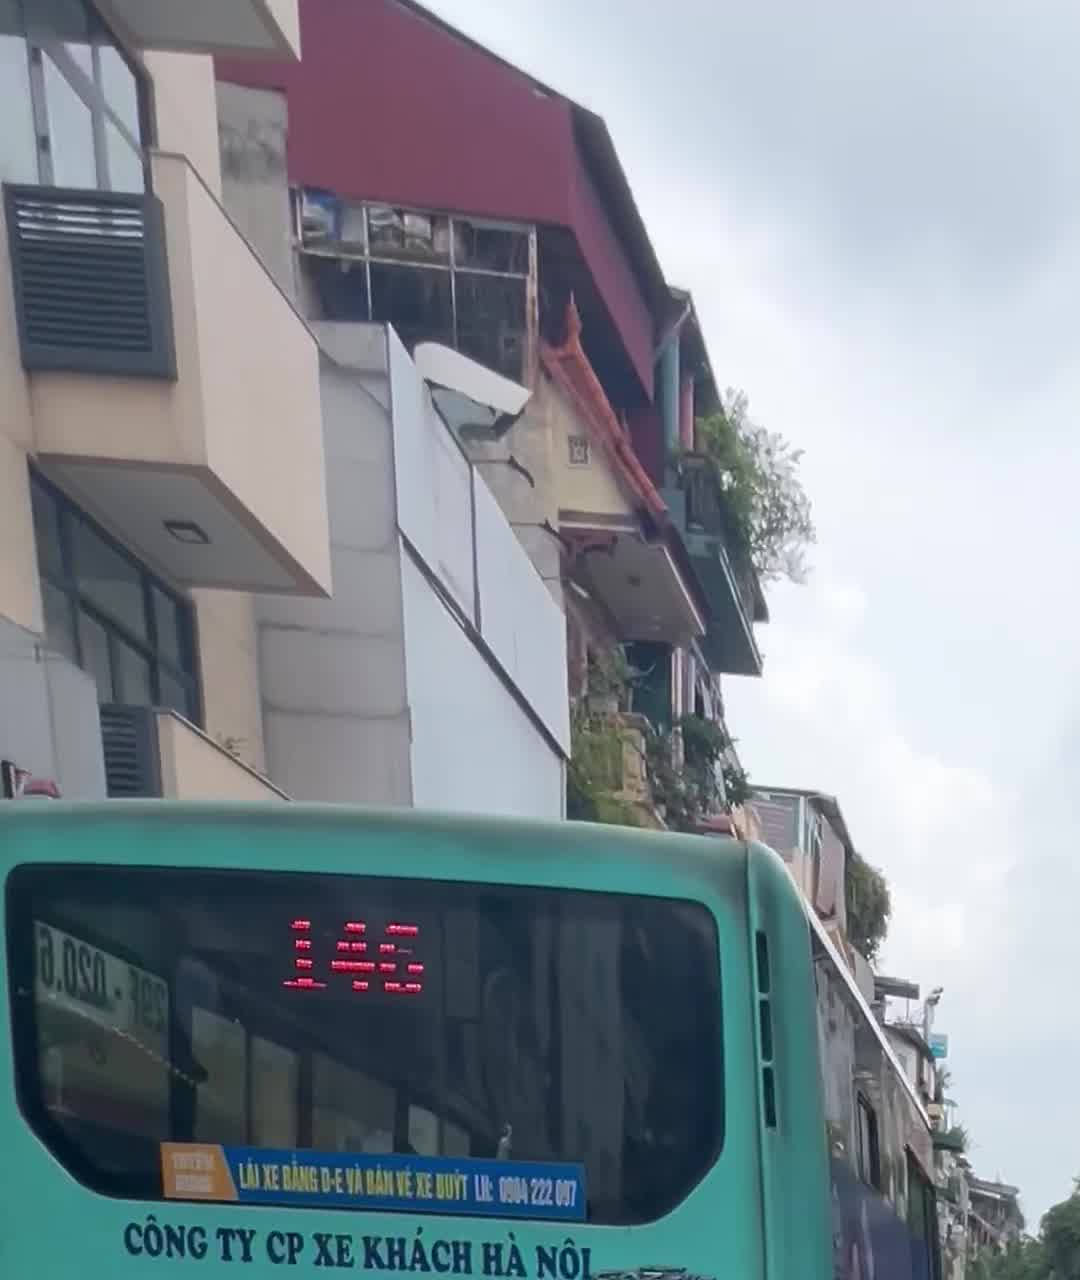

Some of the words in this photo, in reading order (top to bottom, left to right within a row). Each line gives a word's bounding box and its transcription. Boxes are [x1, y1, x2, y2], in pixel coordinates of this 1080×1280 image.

[262, 1164, 279, 1192] XE
[321, 1167, 344, 1194] D-E
[416, 1170, 433, 1199] XE
[530, 1178, 553, 1206] 222
[124, 1214, 208, 1259] CÔNG
[216, 1228, 256, 1262] TY
[266, 1231, 304, 1264] CP
[313, 1233, 354, 1268] XE
[362, 1226, 472, 1274] KHÁCH
[482, 1232, 527, 1278] HÀ
